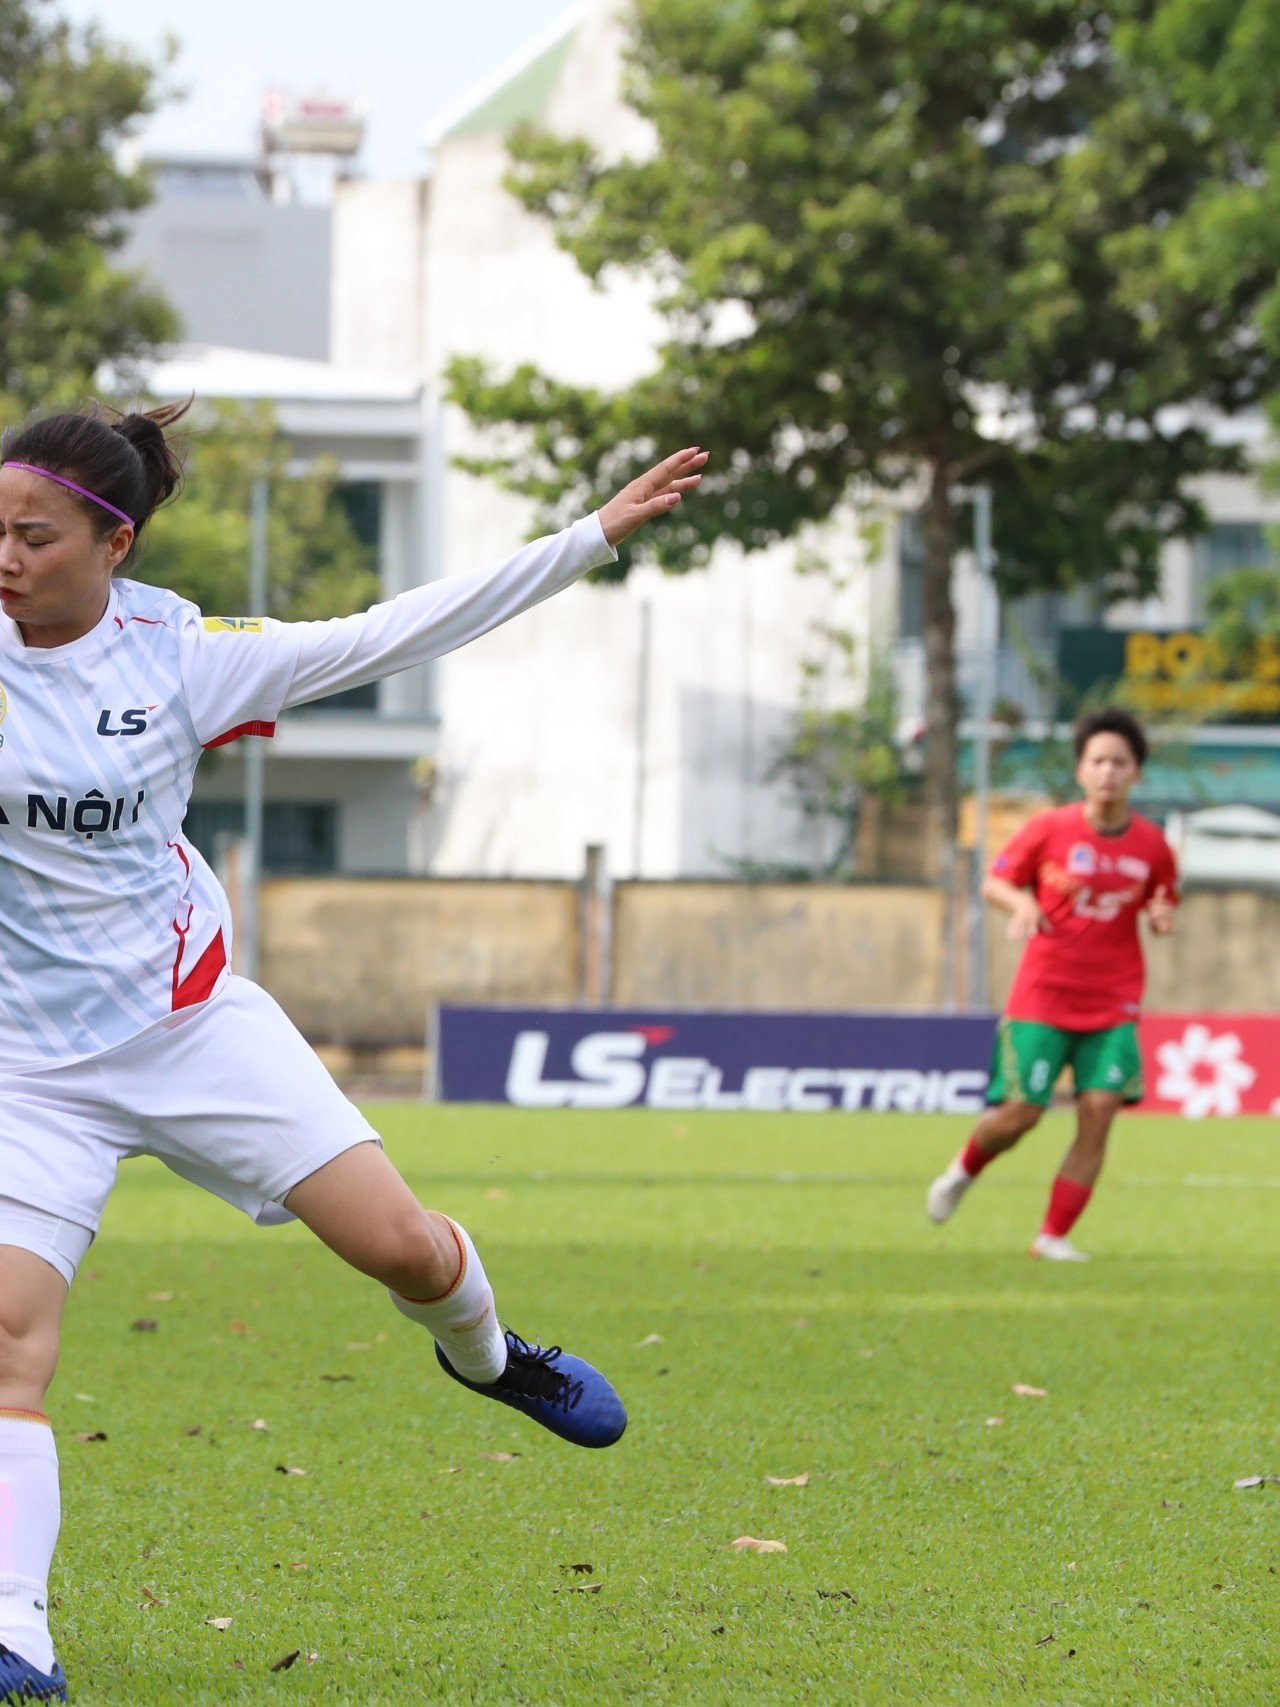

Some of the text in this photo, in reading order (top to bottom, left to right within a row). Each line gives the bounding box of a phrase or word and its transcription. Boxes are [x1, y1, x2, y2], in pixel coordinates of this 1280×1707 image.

[97, 706, 149, 737] LS
[26, 788, 145, 840] NỘI
[505, 1030, 990, 1113] LS ELECTRIC
